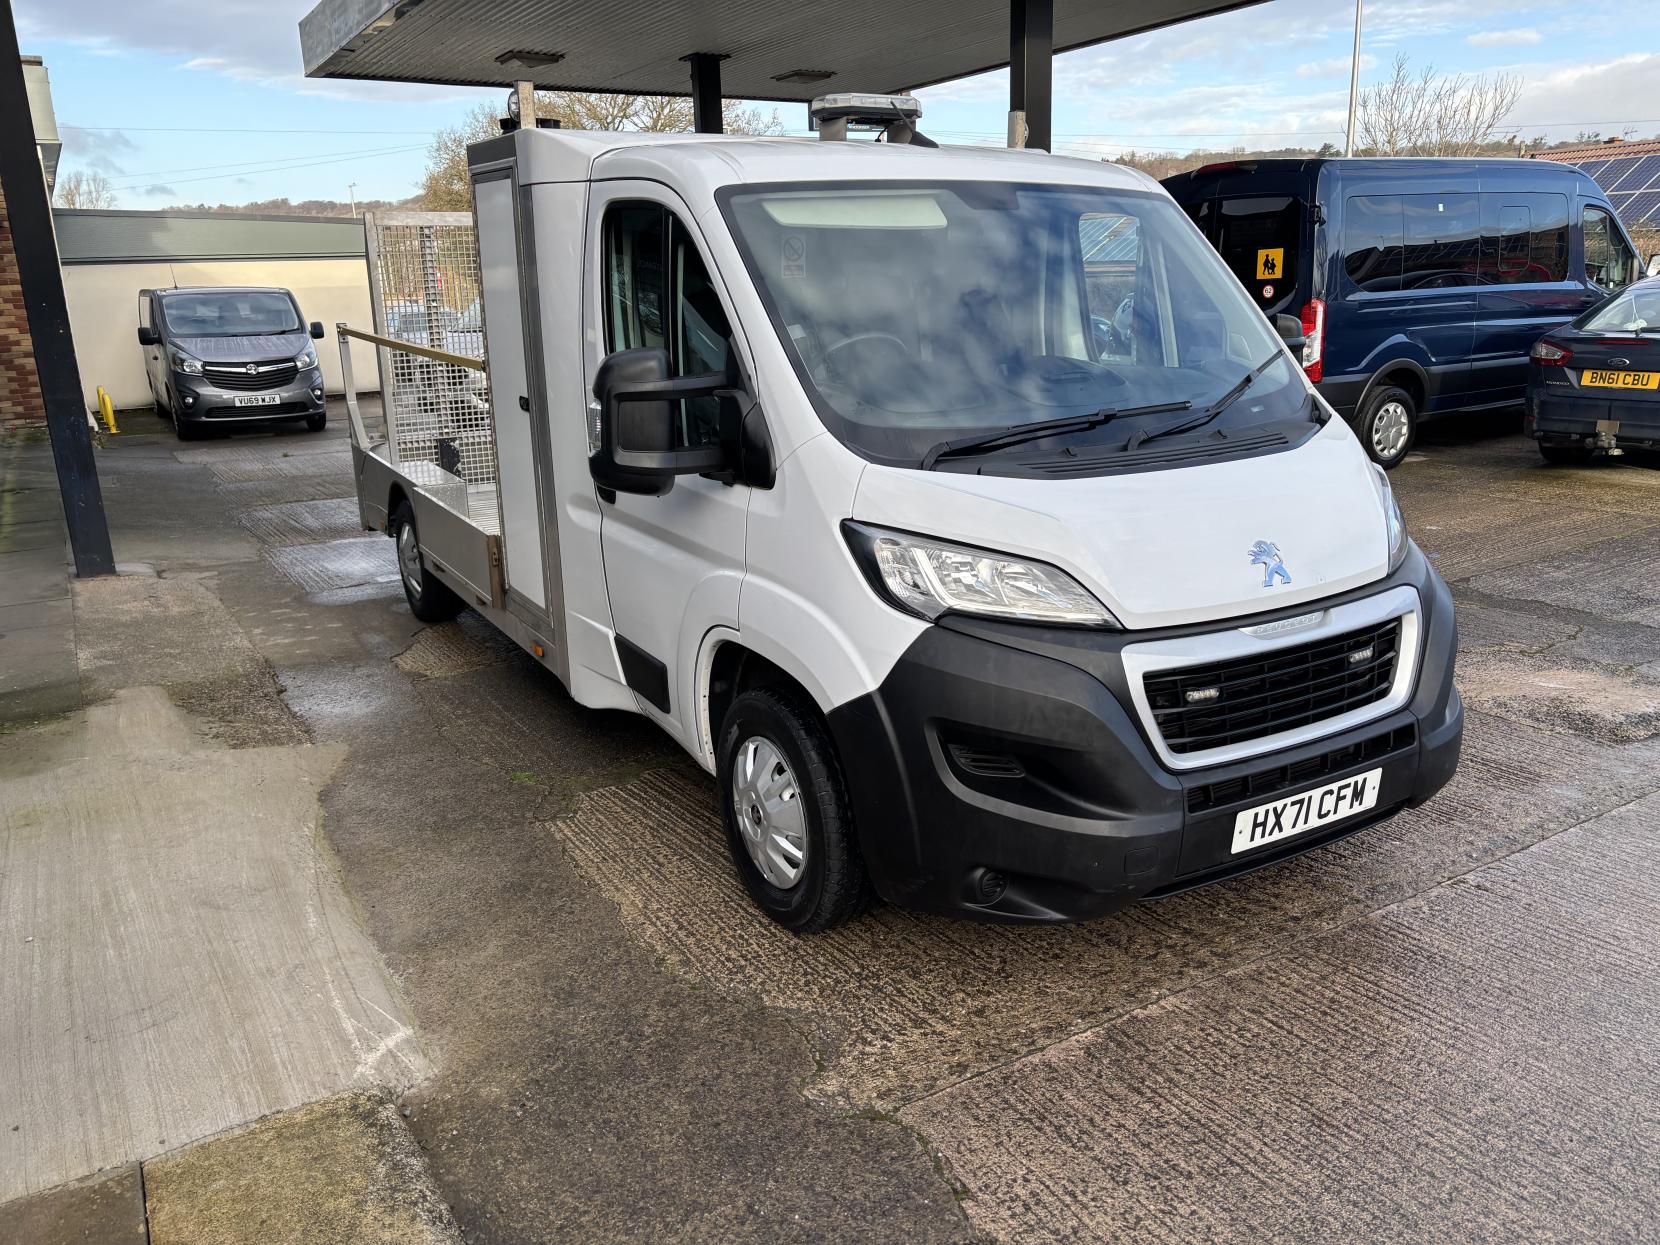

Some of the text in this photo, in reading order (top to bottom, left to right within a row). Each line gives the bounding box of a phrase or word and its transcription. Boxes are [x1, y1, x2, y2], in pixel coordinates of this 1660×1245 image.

[1589, 371, 1651, 386] BN61 CBU
[238, 395, 277, 405] VU69 WJX
[1249, 776, 1368, 843] HX71 CFM
